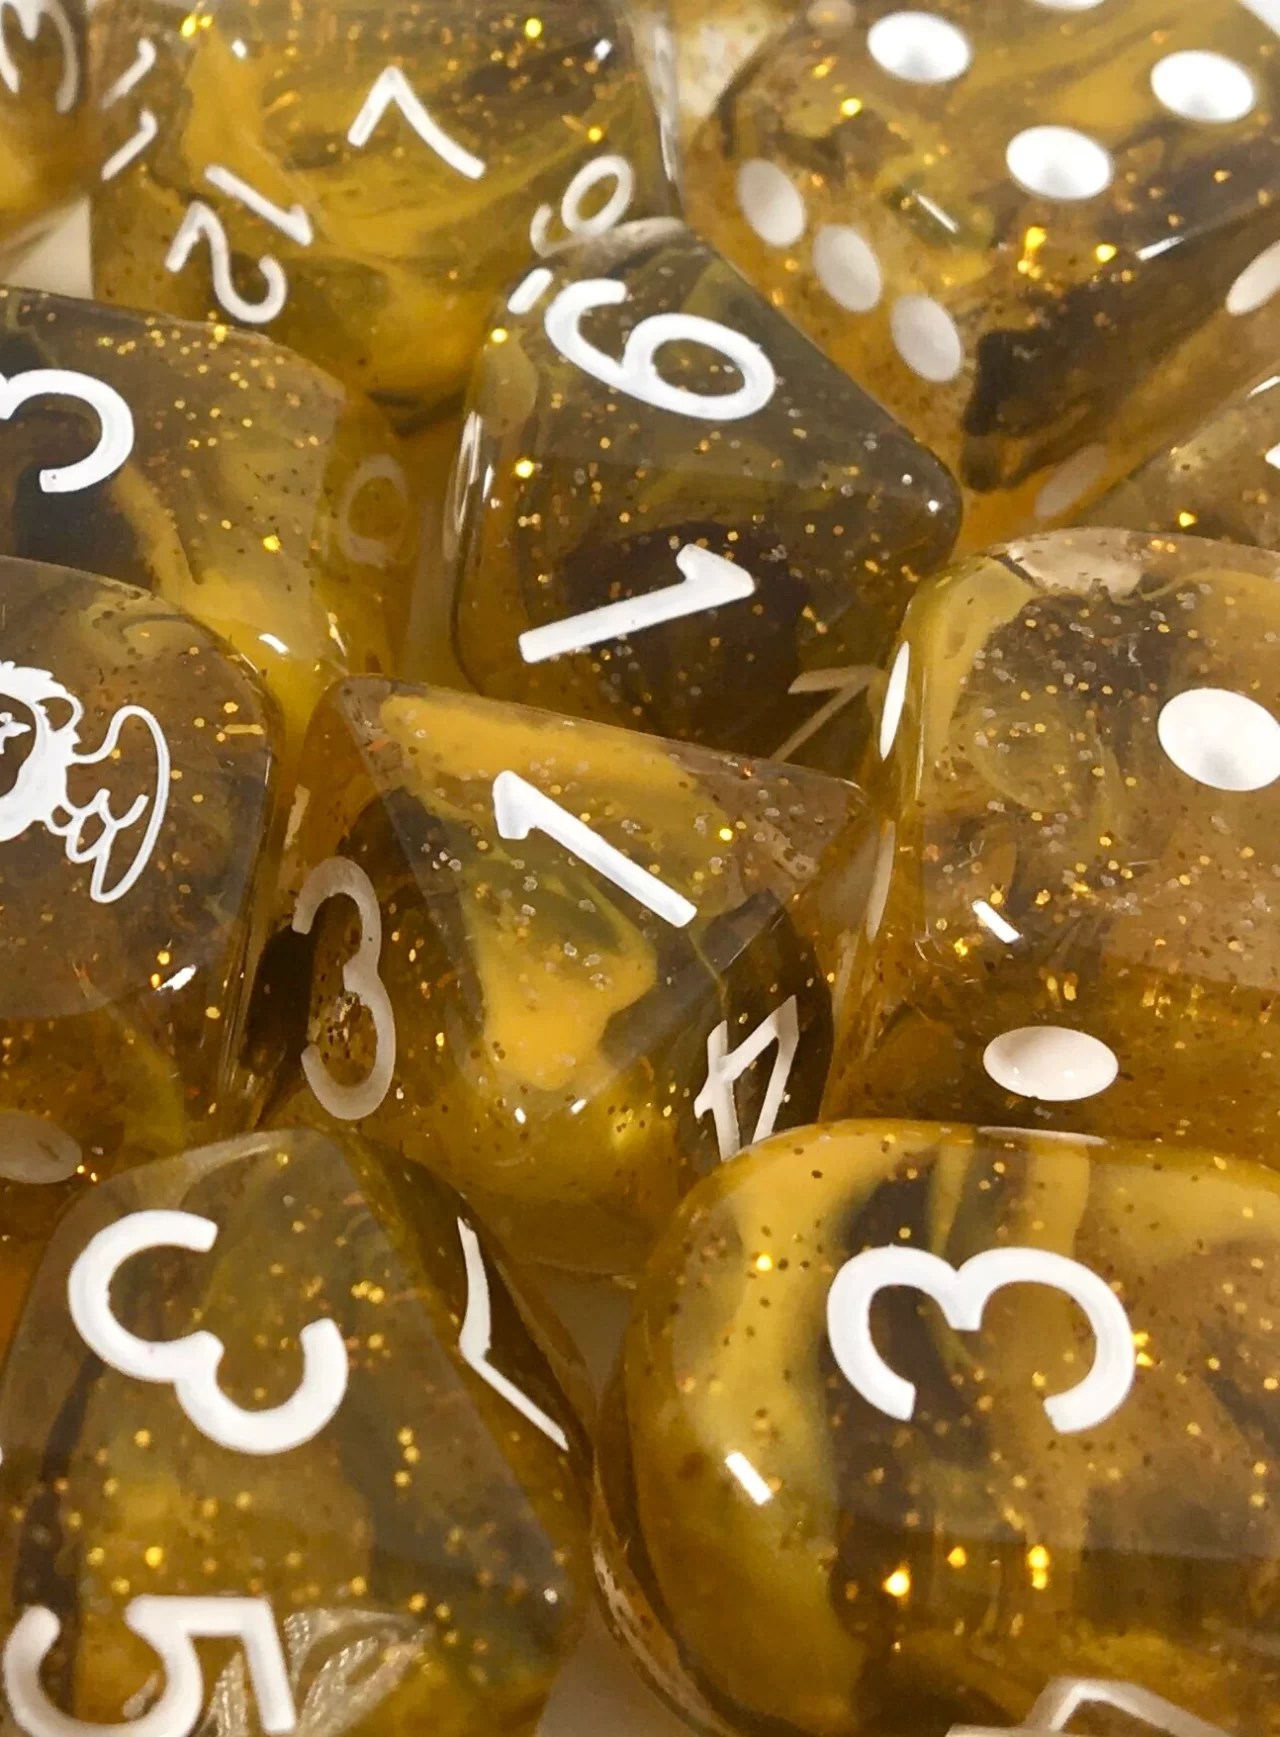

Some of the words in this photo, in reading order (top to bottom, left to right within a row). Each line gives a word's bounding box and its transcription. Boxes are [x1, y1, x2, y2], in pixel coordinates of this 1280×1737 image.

[347, 65, 486, 181] 7
[519, 543, 756, 664] 1
[492, 769, 698, 928] 1
[291, 856, 397, 1121] 3
[67, 1208, 349, 1456] 3
[826, 1245, 1137, 1434] 3
[1, 1594, 297, 1737] 5
